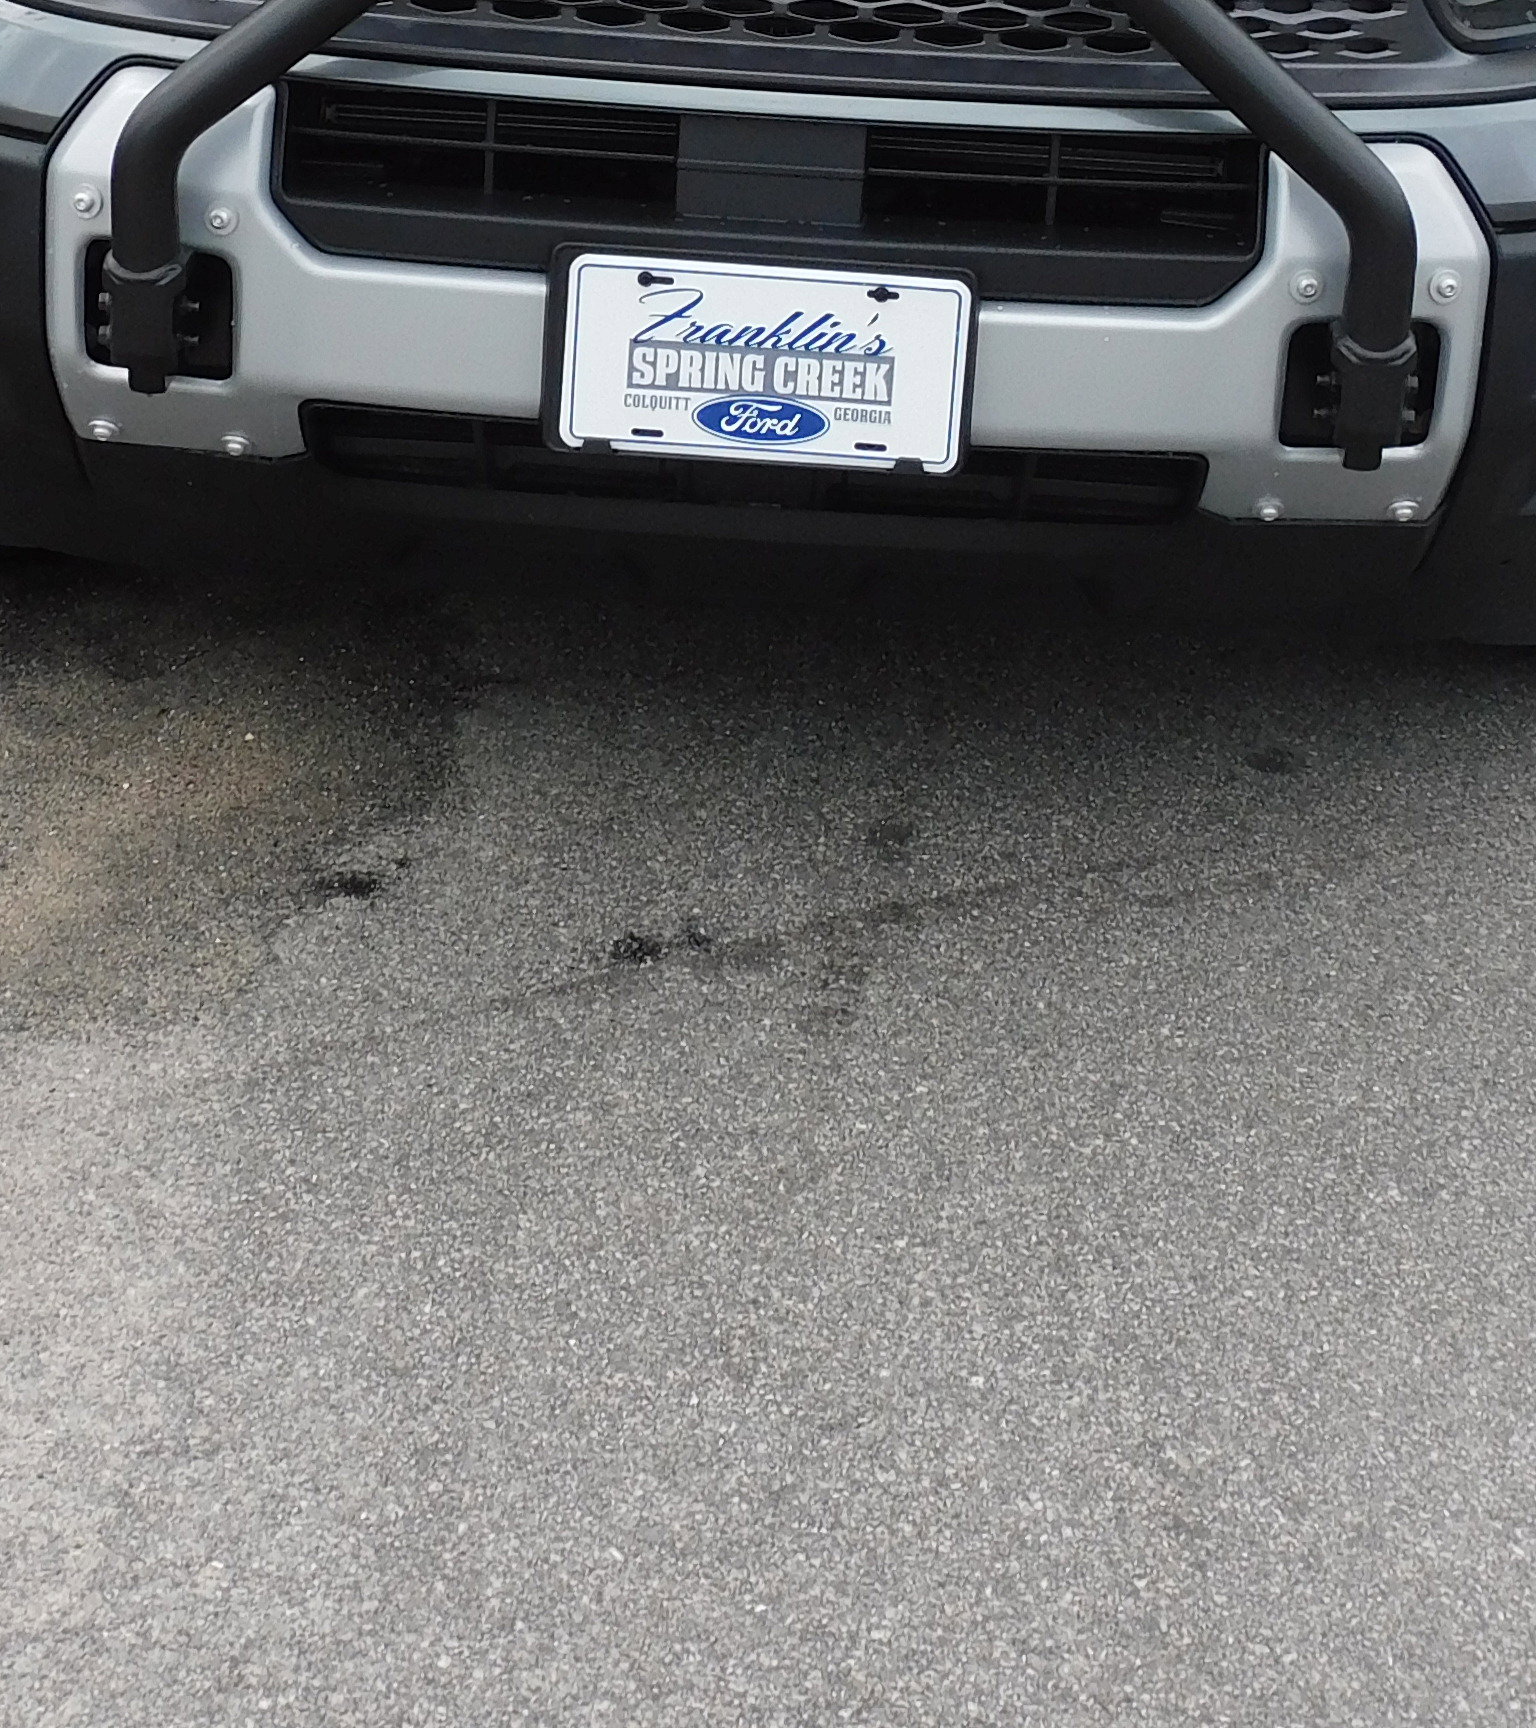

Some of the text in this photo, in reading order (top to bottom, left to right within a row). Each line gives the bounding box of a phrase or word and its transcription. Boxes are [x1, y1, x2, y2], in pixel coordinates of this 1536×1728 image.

[630, 288, 895, 357] Franklin's
[631, 346, 891, 402] SPRING CREEK
[623, 393, 893, 425] COLQUITT GEORGIA
[719, 400, 801, 437] Ford
